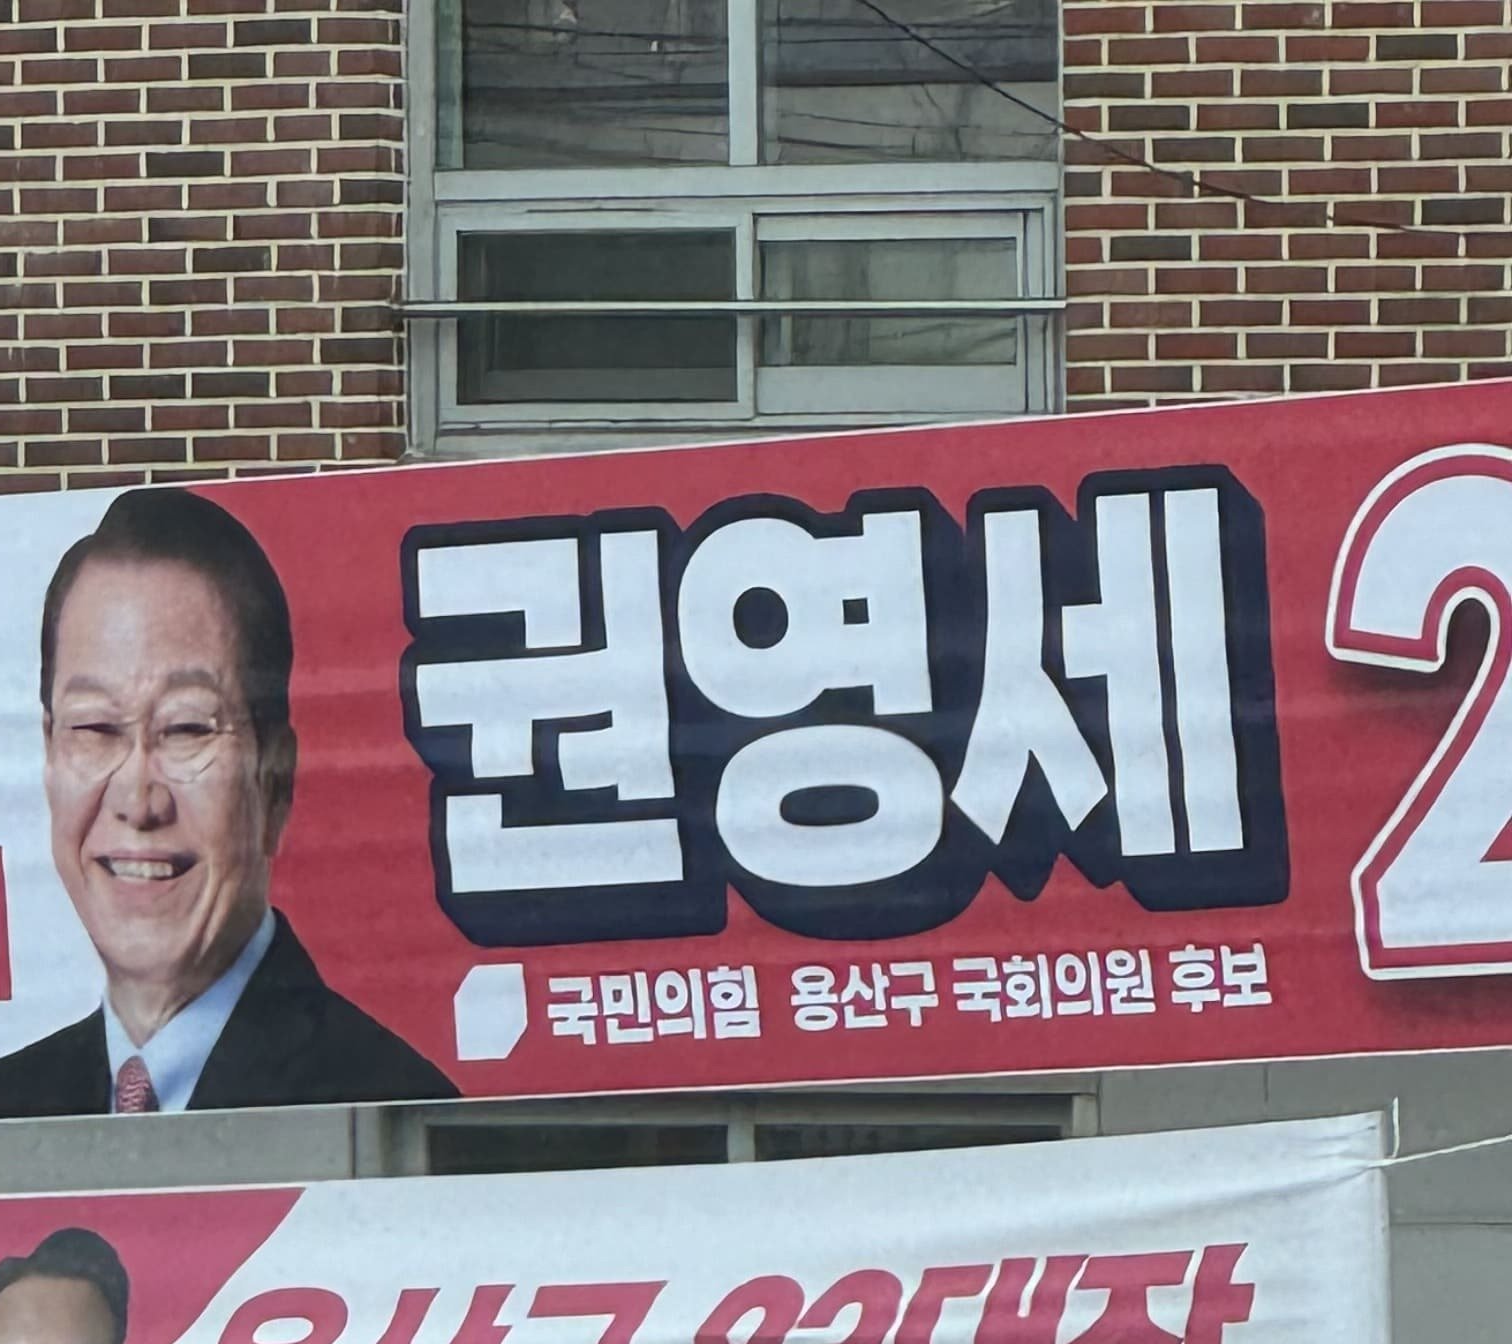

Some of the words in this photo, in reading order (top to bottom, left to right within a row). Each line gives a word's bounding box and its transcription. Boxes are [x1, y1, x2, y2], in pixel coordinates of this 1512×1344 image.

[415, 486, 1246, 893] 권영세
[544, 964, 763, 1045] 국민의힘
[788, 958, 942, 1033] 용산구
[951, 948, 1158, 1024] 국회의원
[1168, 942, 1273, 1012] 후보
